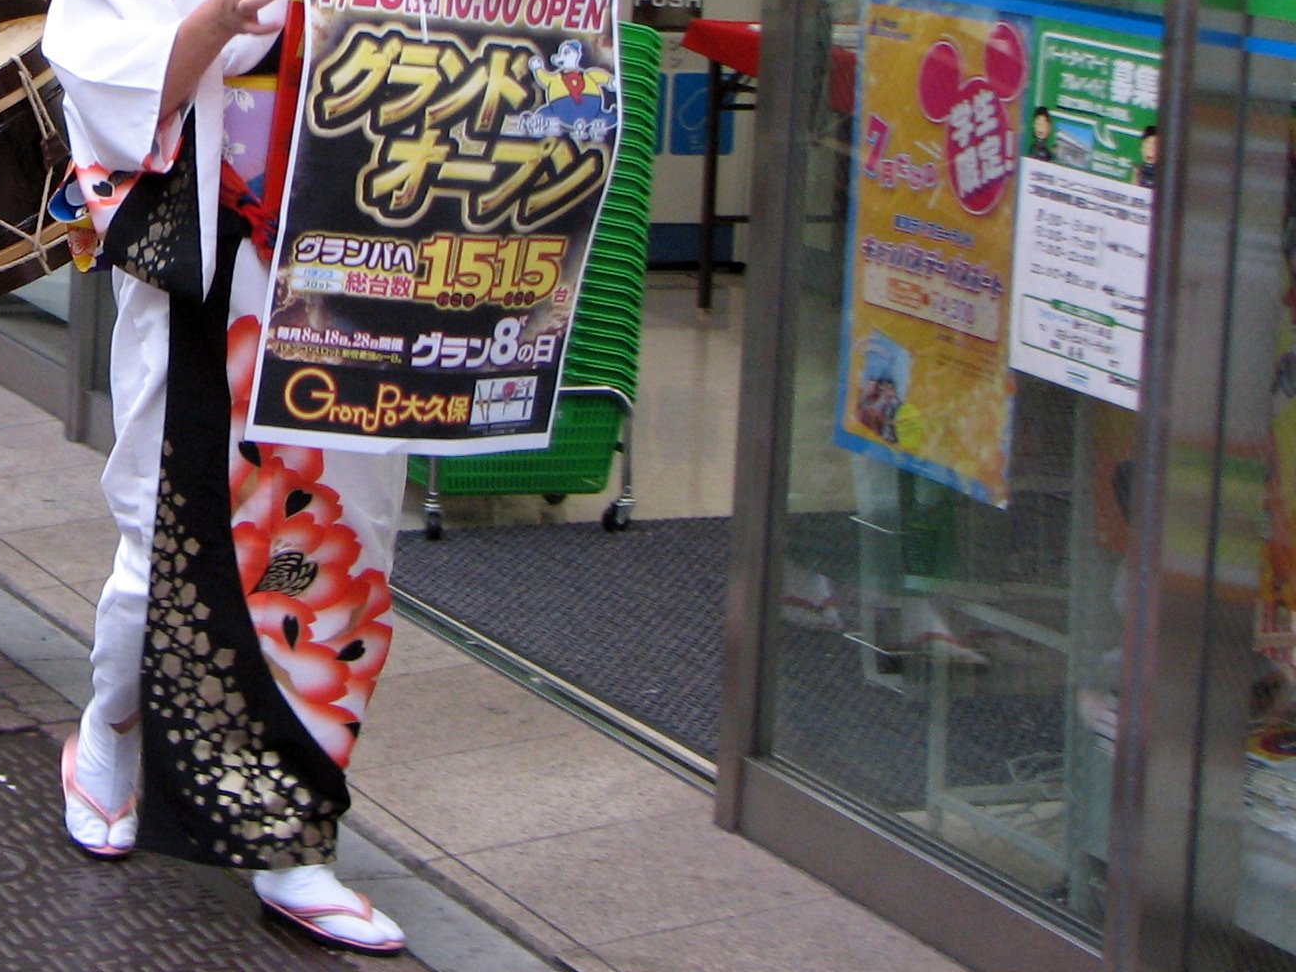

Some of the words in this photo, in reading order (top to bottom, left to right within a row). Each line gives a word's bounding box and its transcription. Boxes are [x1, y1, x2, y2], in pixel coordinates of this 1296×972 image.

[318, 33, 531, 133] グランド
[369, 127, 600, 218] オープン
[345, 271, 413, 298] 総台数
[400, 394, 471, 424] 大久保
